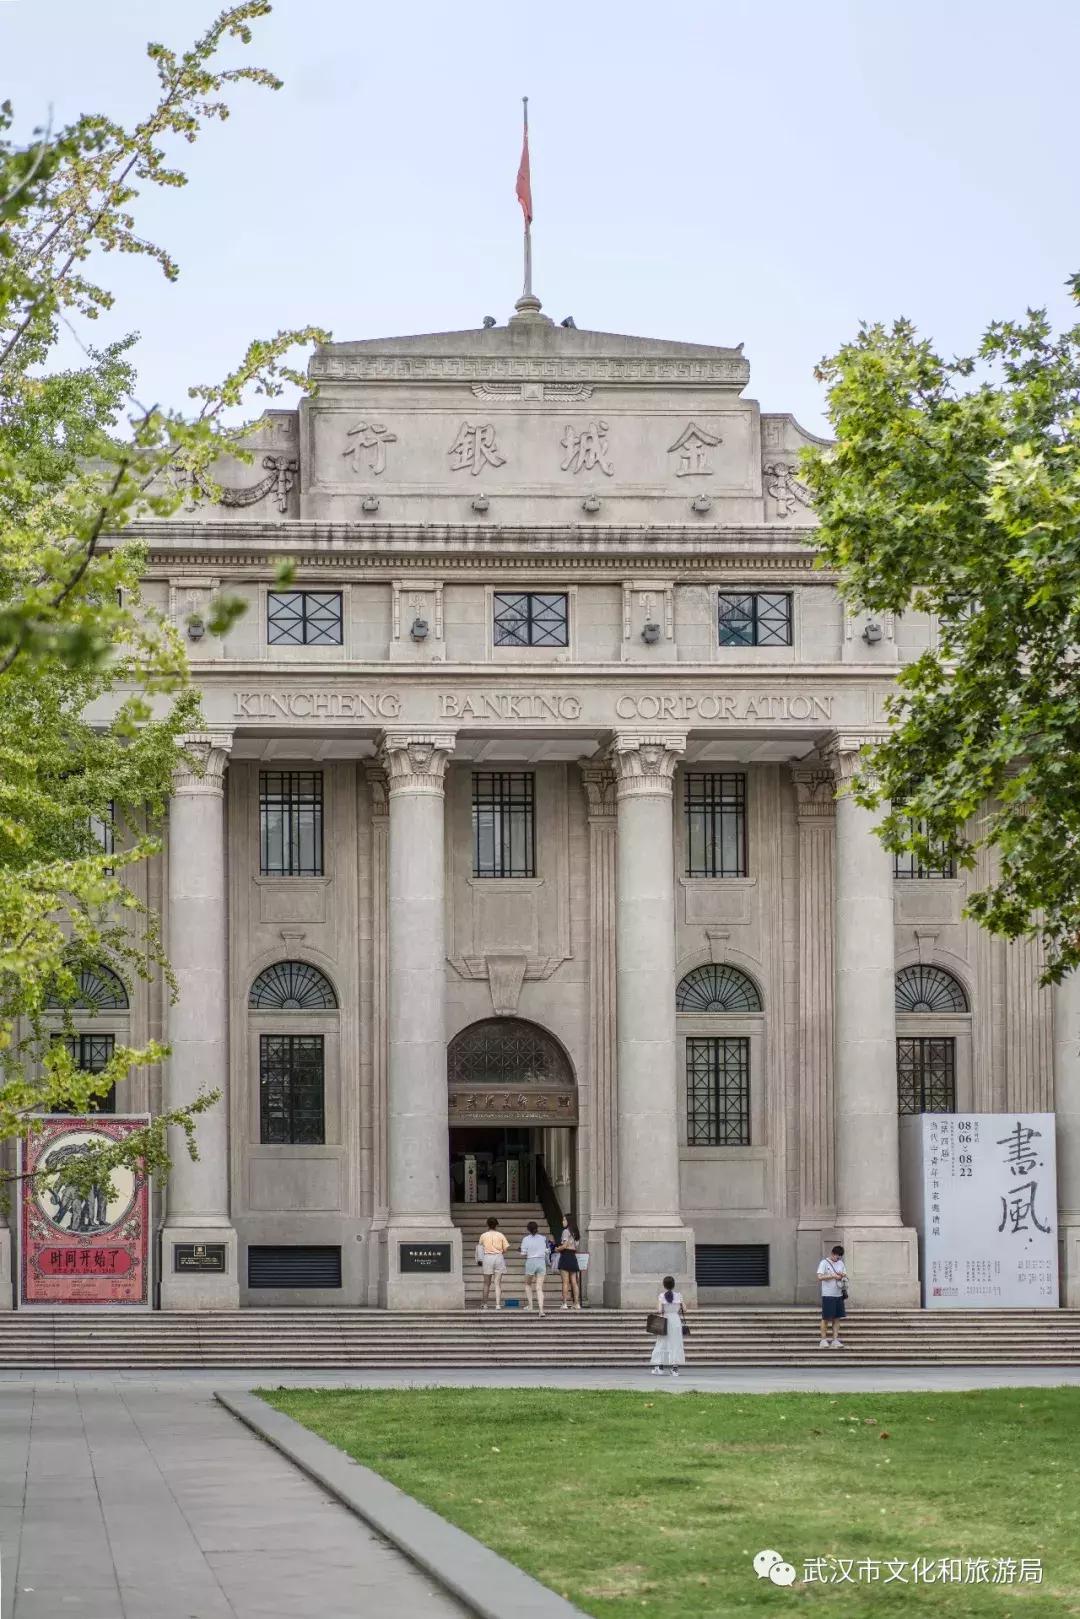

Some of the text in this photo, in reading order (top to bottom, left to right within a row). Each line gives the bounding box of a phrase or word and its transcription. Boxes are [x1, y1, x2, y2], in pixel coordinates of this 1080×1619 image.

[233, 693, 834, 720] KINCHENG BANKING CORPORATION
[958, 1121, 972, 1131] 08
[958, 1134, 972, 1143] 06
[959, 1154, 973, 1164] 08
[960, 1167, 973, 1177] 22
[50, 1250, 119, 1268] 时间开始了
